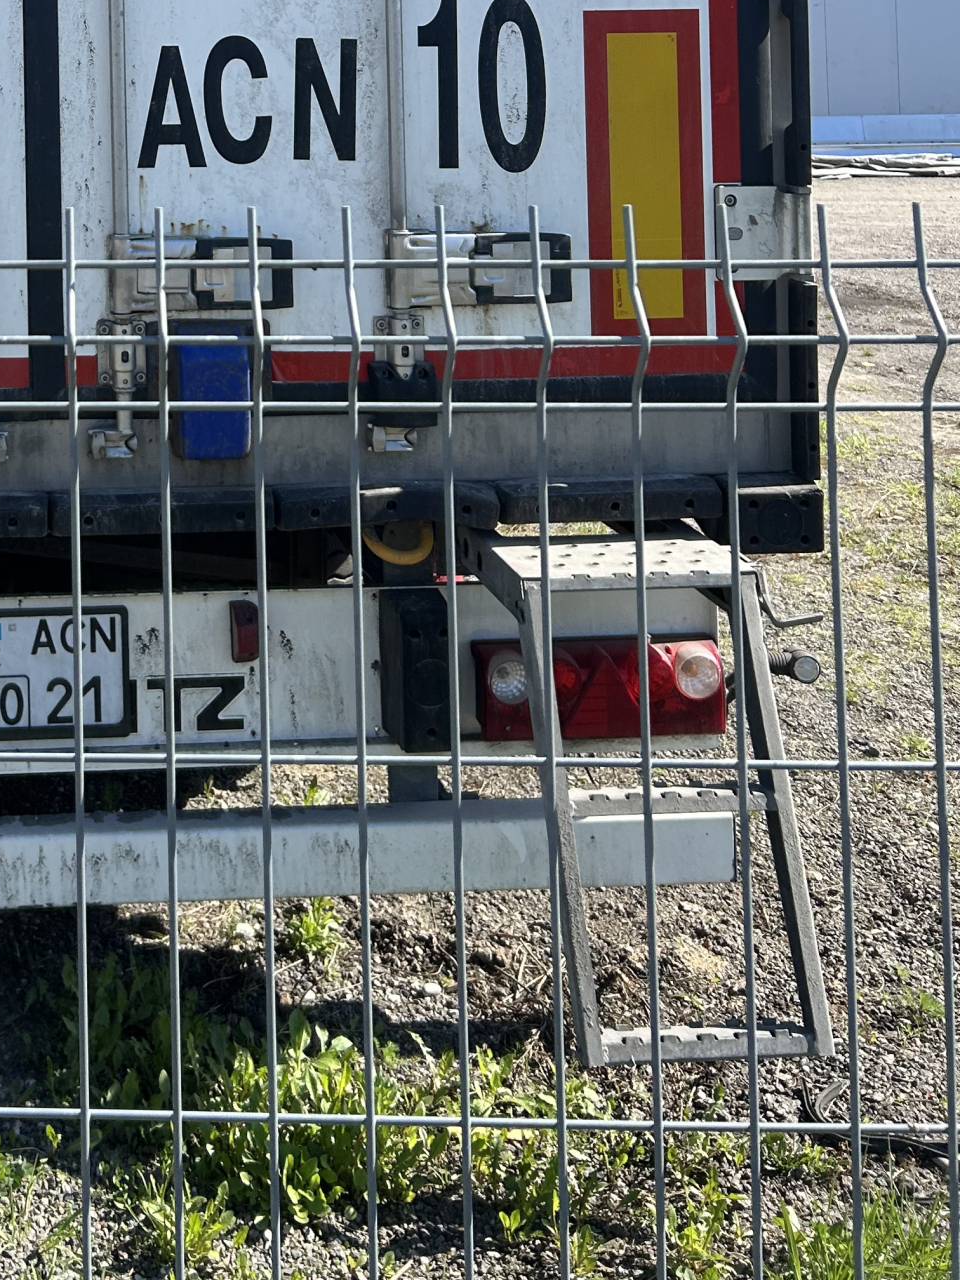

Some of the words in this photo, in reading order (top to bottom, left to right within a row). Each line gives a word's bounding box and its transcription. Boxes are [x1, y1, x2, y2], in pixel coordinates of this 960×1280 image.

[137, 35, 358, 168] ACN
[31, 616, 117, 655] ACN
[46, 676, 102, 724] 21
